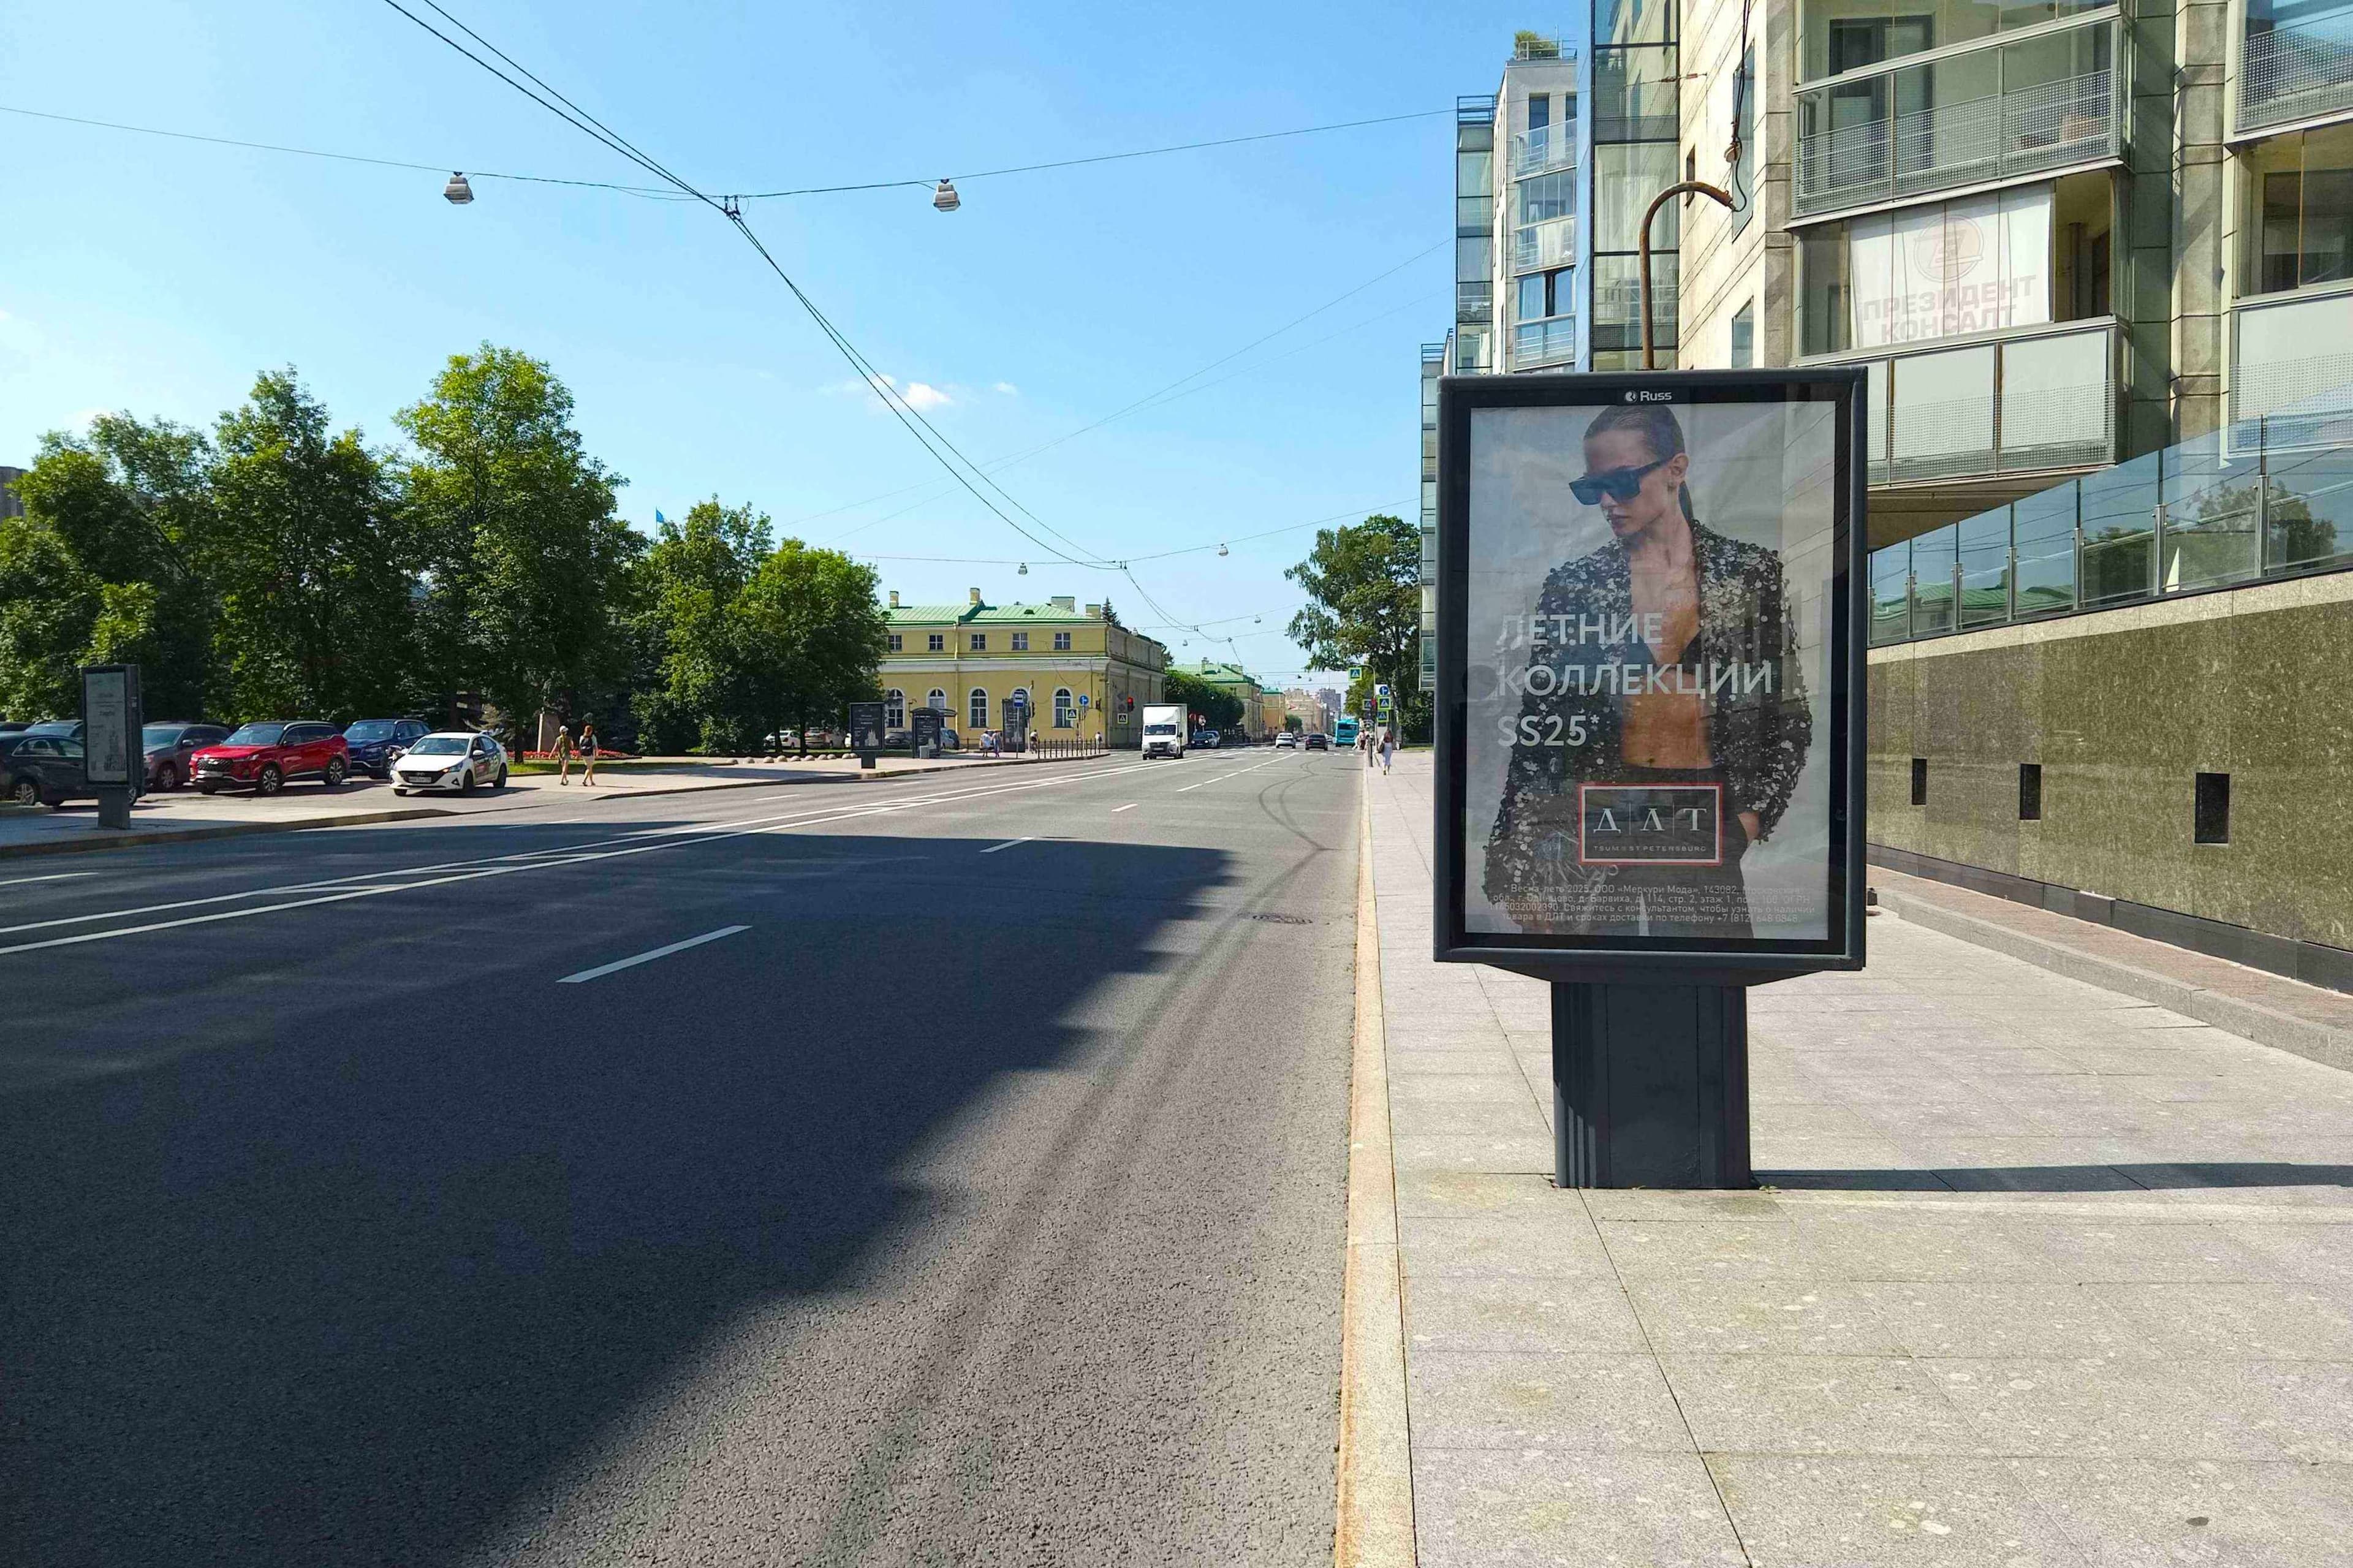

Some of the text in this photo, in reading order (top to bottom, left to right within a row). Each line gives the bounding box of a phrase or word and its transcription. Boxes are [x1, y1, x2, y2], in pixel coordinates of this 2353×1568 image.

[1863, 273, 2037, 320] ПРЕЗИДЕНТ
[1881, 304, 2017, 343] КОНСАЛТ
[1640, 390, 1672, 402] Russ
[1495, 612, 1664, 647] ЛЕТНИЕ
[1499, 662, 1771, 700] КОЛЛЕКЦИИ
[1594, 884, 1615, 893] ООО
[1563, 903, 1616, 912] Свяжитесь
[1700, 904, 1729, 913] чтобы
[1669, 914, 1715, 924] телефону
